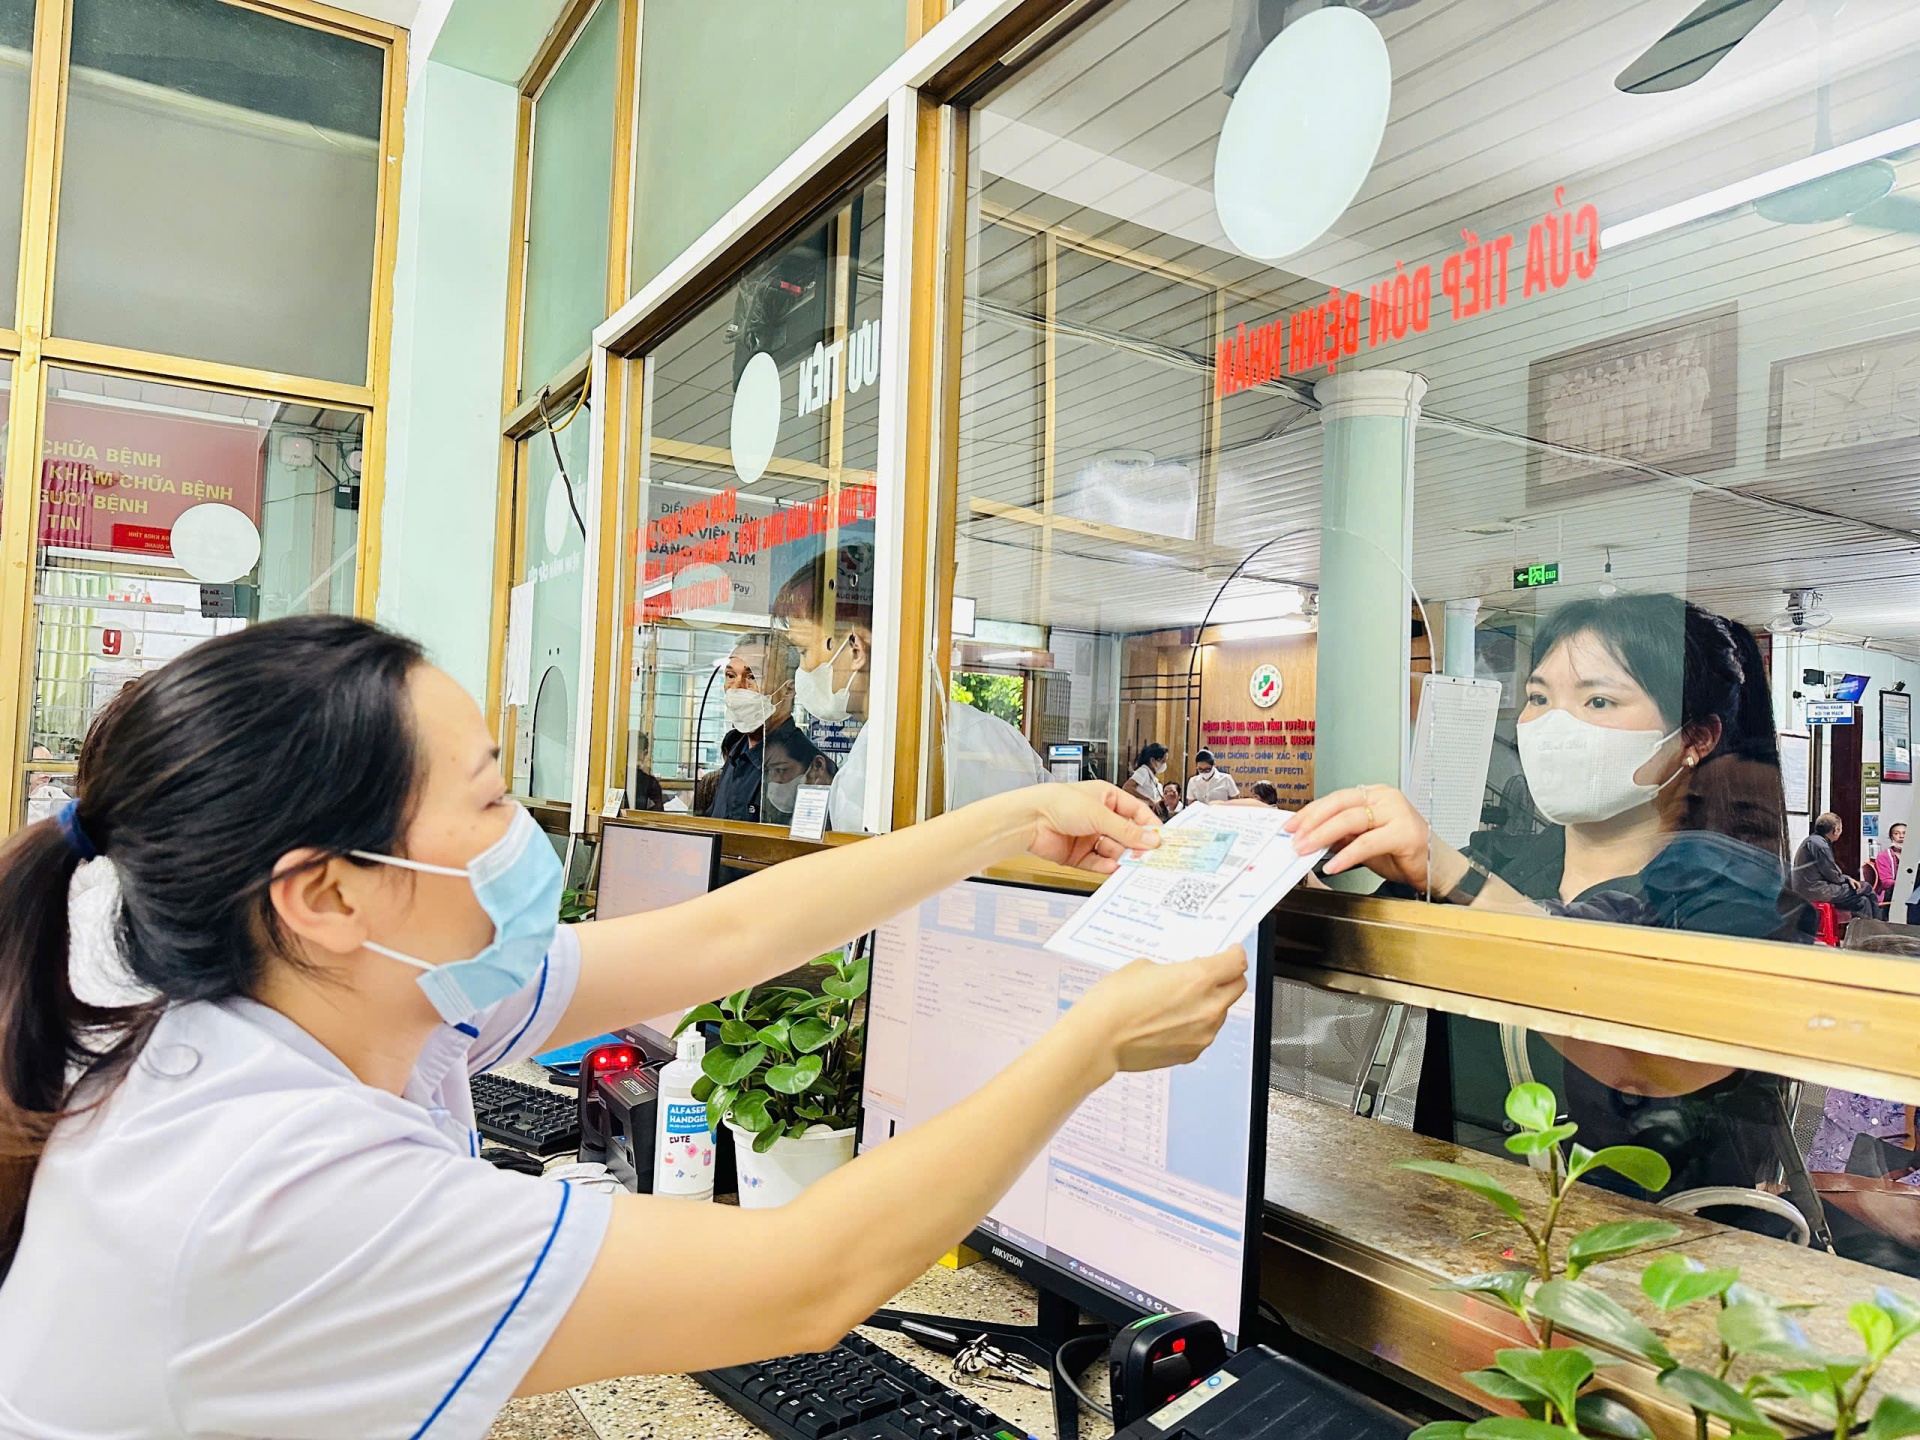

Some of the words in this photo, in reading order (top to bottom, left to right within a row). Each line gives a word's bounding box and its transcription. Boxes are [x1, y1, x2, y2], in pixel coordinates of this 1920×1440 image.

[106, 447, 161, 468] BỆNH
[50, 465, 113, 486] KHÁM
[120, 473, 176, 494] CHỮA
[181, 479, 233, 501] BỆNH
[93, 494, 148, 515] BỆNH
[47, 514, 81, 531] TIN
[726, 551, 756, 565] ATM
[1545, 570, 1556, 579] EXIT
[102, 629, 122, 655] 9
[1235, 766, 1269, 774] ACCURATE
[669, 1135, 691, 1144] CUTE
[992, 1245, 1024, 1269] HIKVISION
